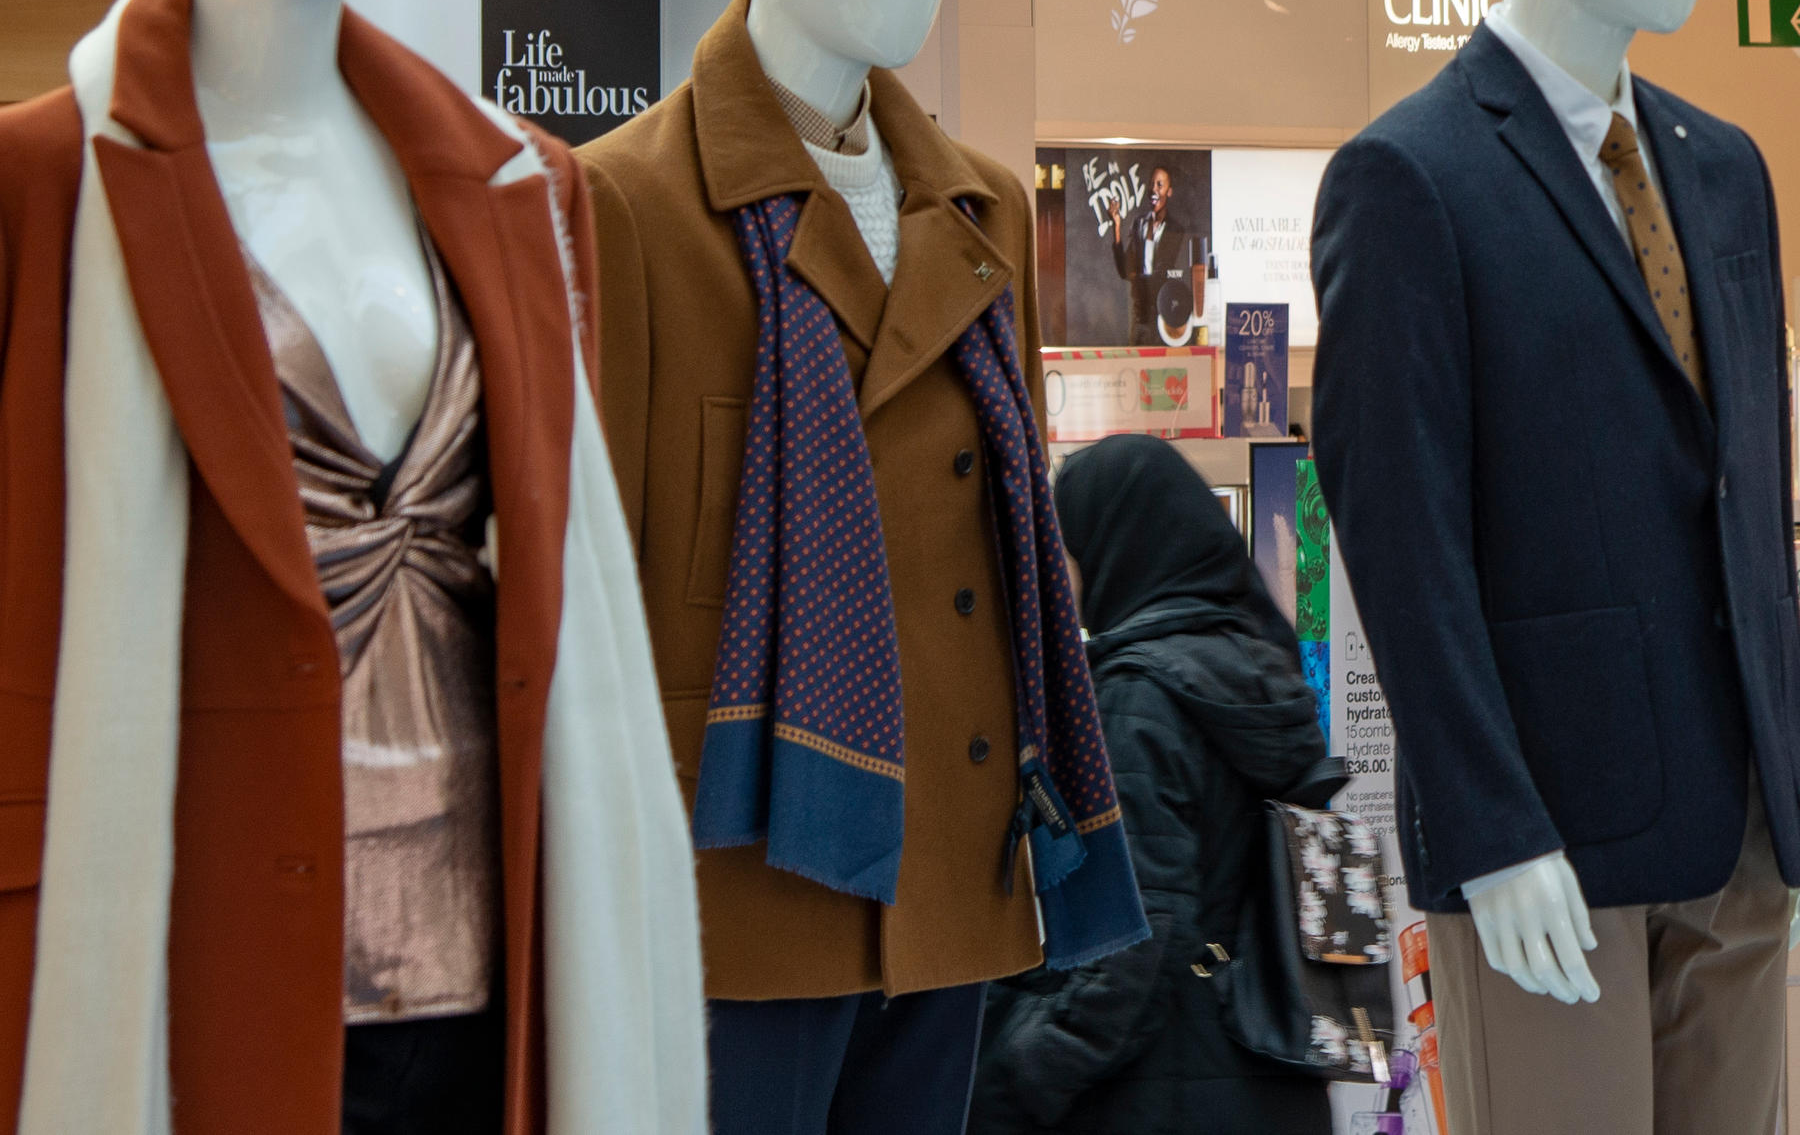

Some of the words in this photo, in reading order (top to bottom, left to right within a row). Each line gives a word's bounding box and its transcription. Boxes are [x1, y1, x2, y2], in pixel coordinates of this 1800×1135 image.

[503, 29, 563, 68] Life
[1385, 32, 1420, 53] Allergy
[539, 66, 575, 83] made
[493, 68, 649, 116] fabulous
[1232, 217, 1302, 232] AVAILABLE
[1239, 310, 1274, 336] 20%
[1346, 671, 1376, 685] Crea
[1346, 689, 1384, 703] custo
[1345, 726, 1358, 739] 15
[1346, 742, 1390, 759] Hydrate
[1346, 792, 1358, 801] No
[1346, 803, 1358, 812] No
